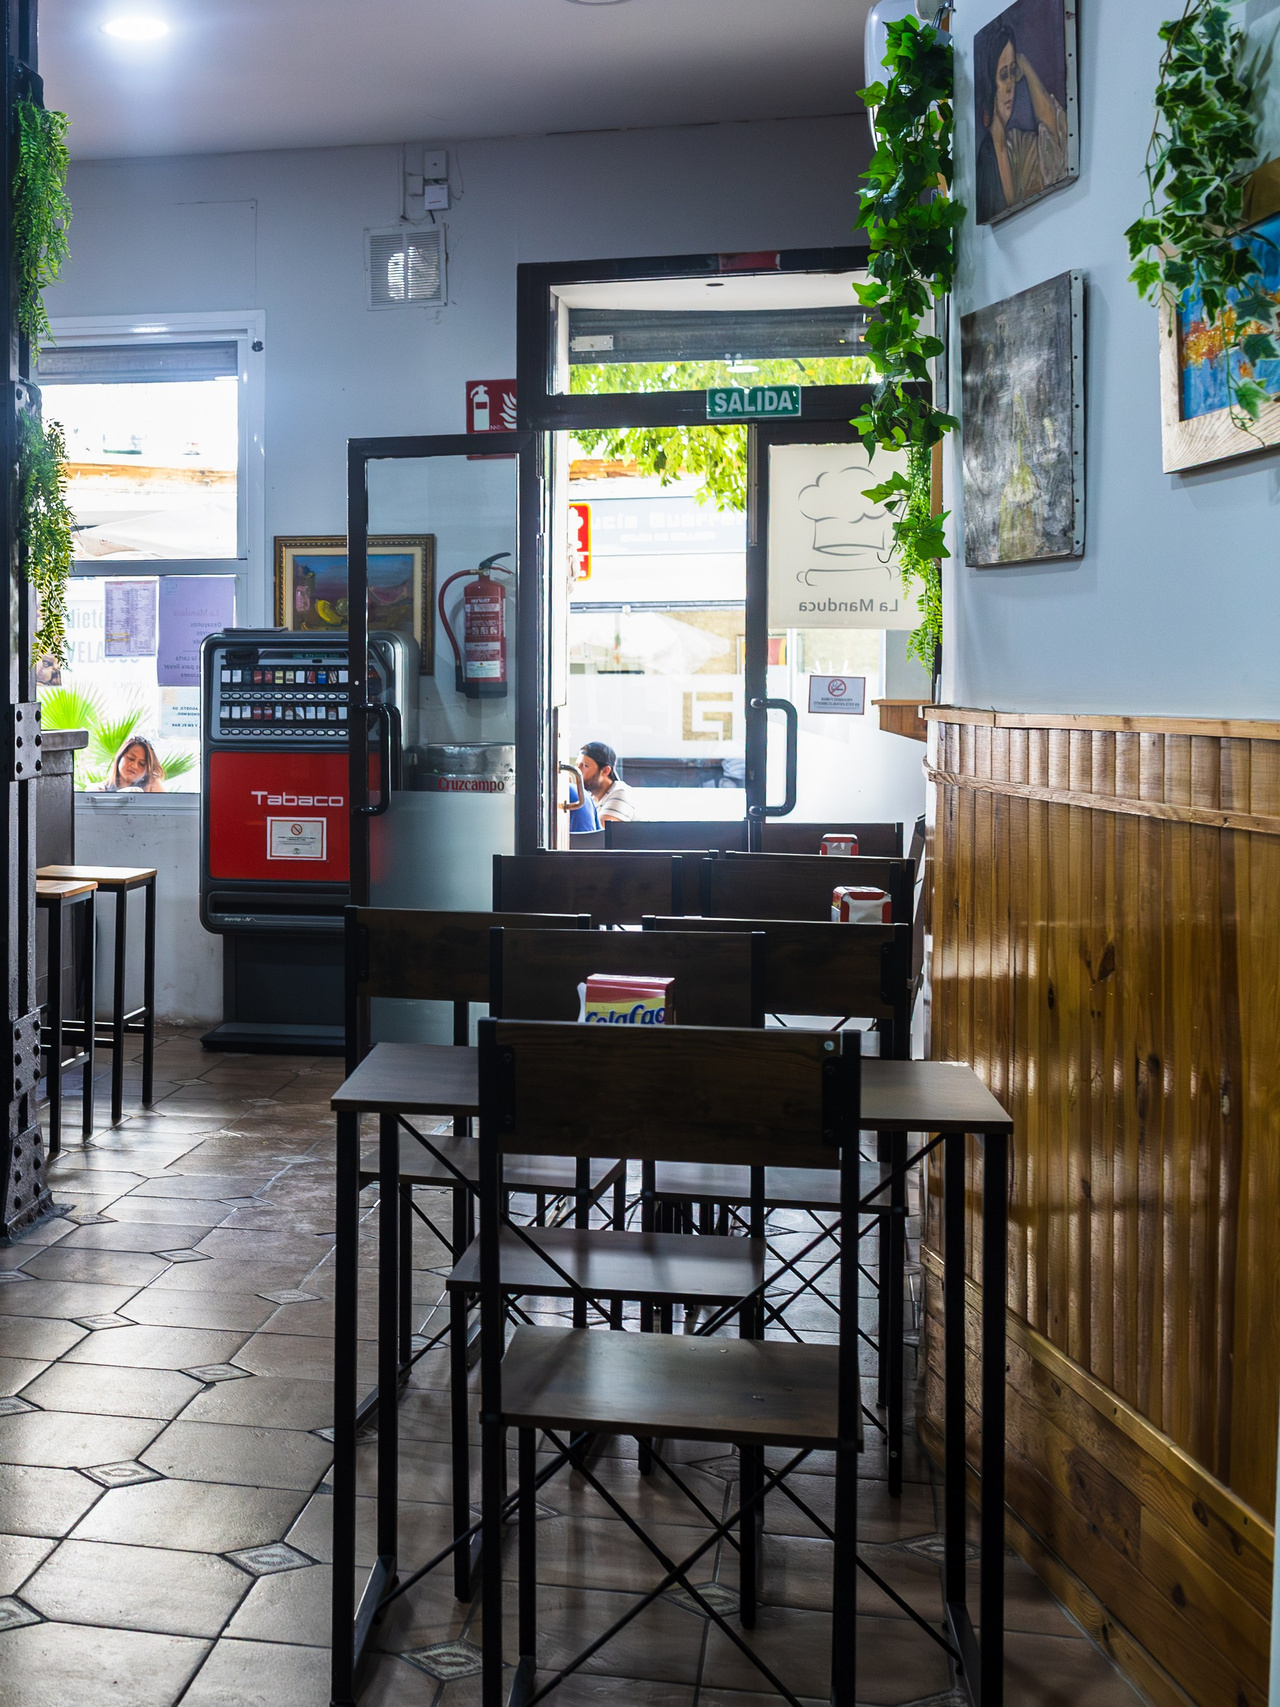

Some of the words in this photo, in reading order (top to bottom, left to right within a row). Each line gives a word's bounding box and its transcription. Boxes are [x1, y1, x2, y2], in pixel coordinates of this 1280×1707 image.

[714, 389, 794, 415] SALIDA
[591, 512, 638, 530] ucía
[437, 775, 505, 793] Cruzcampo
[250, 790, 344, 807] Tabaco
